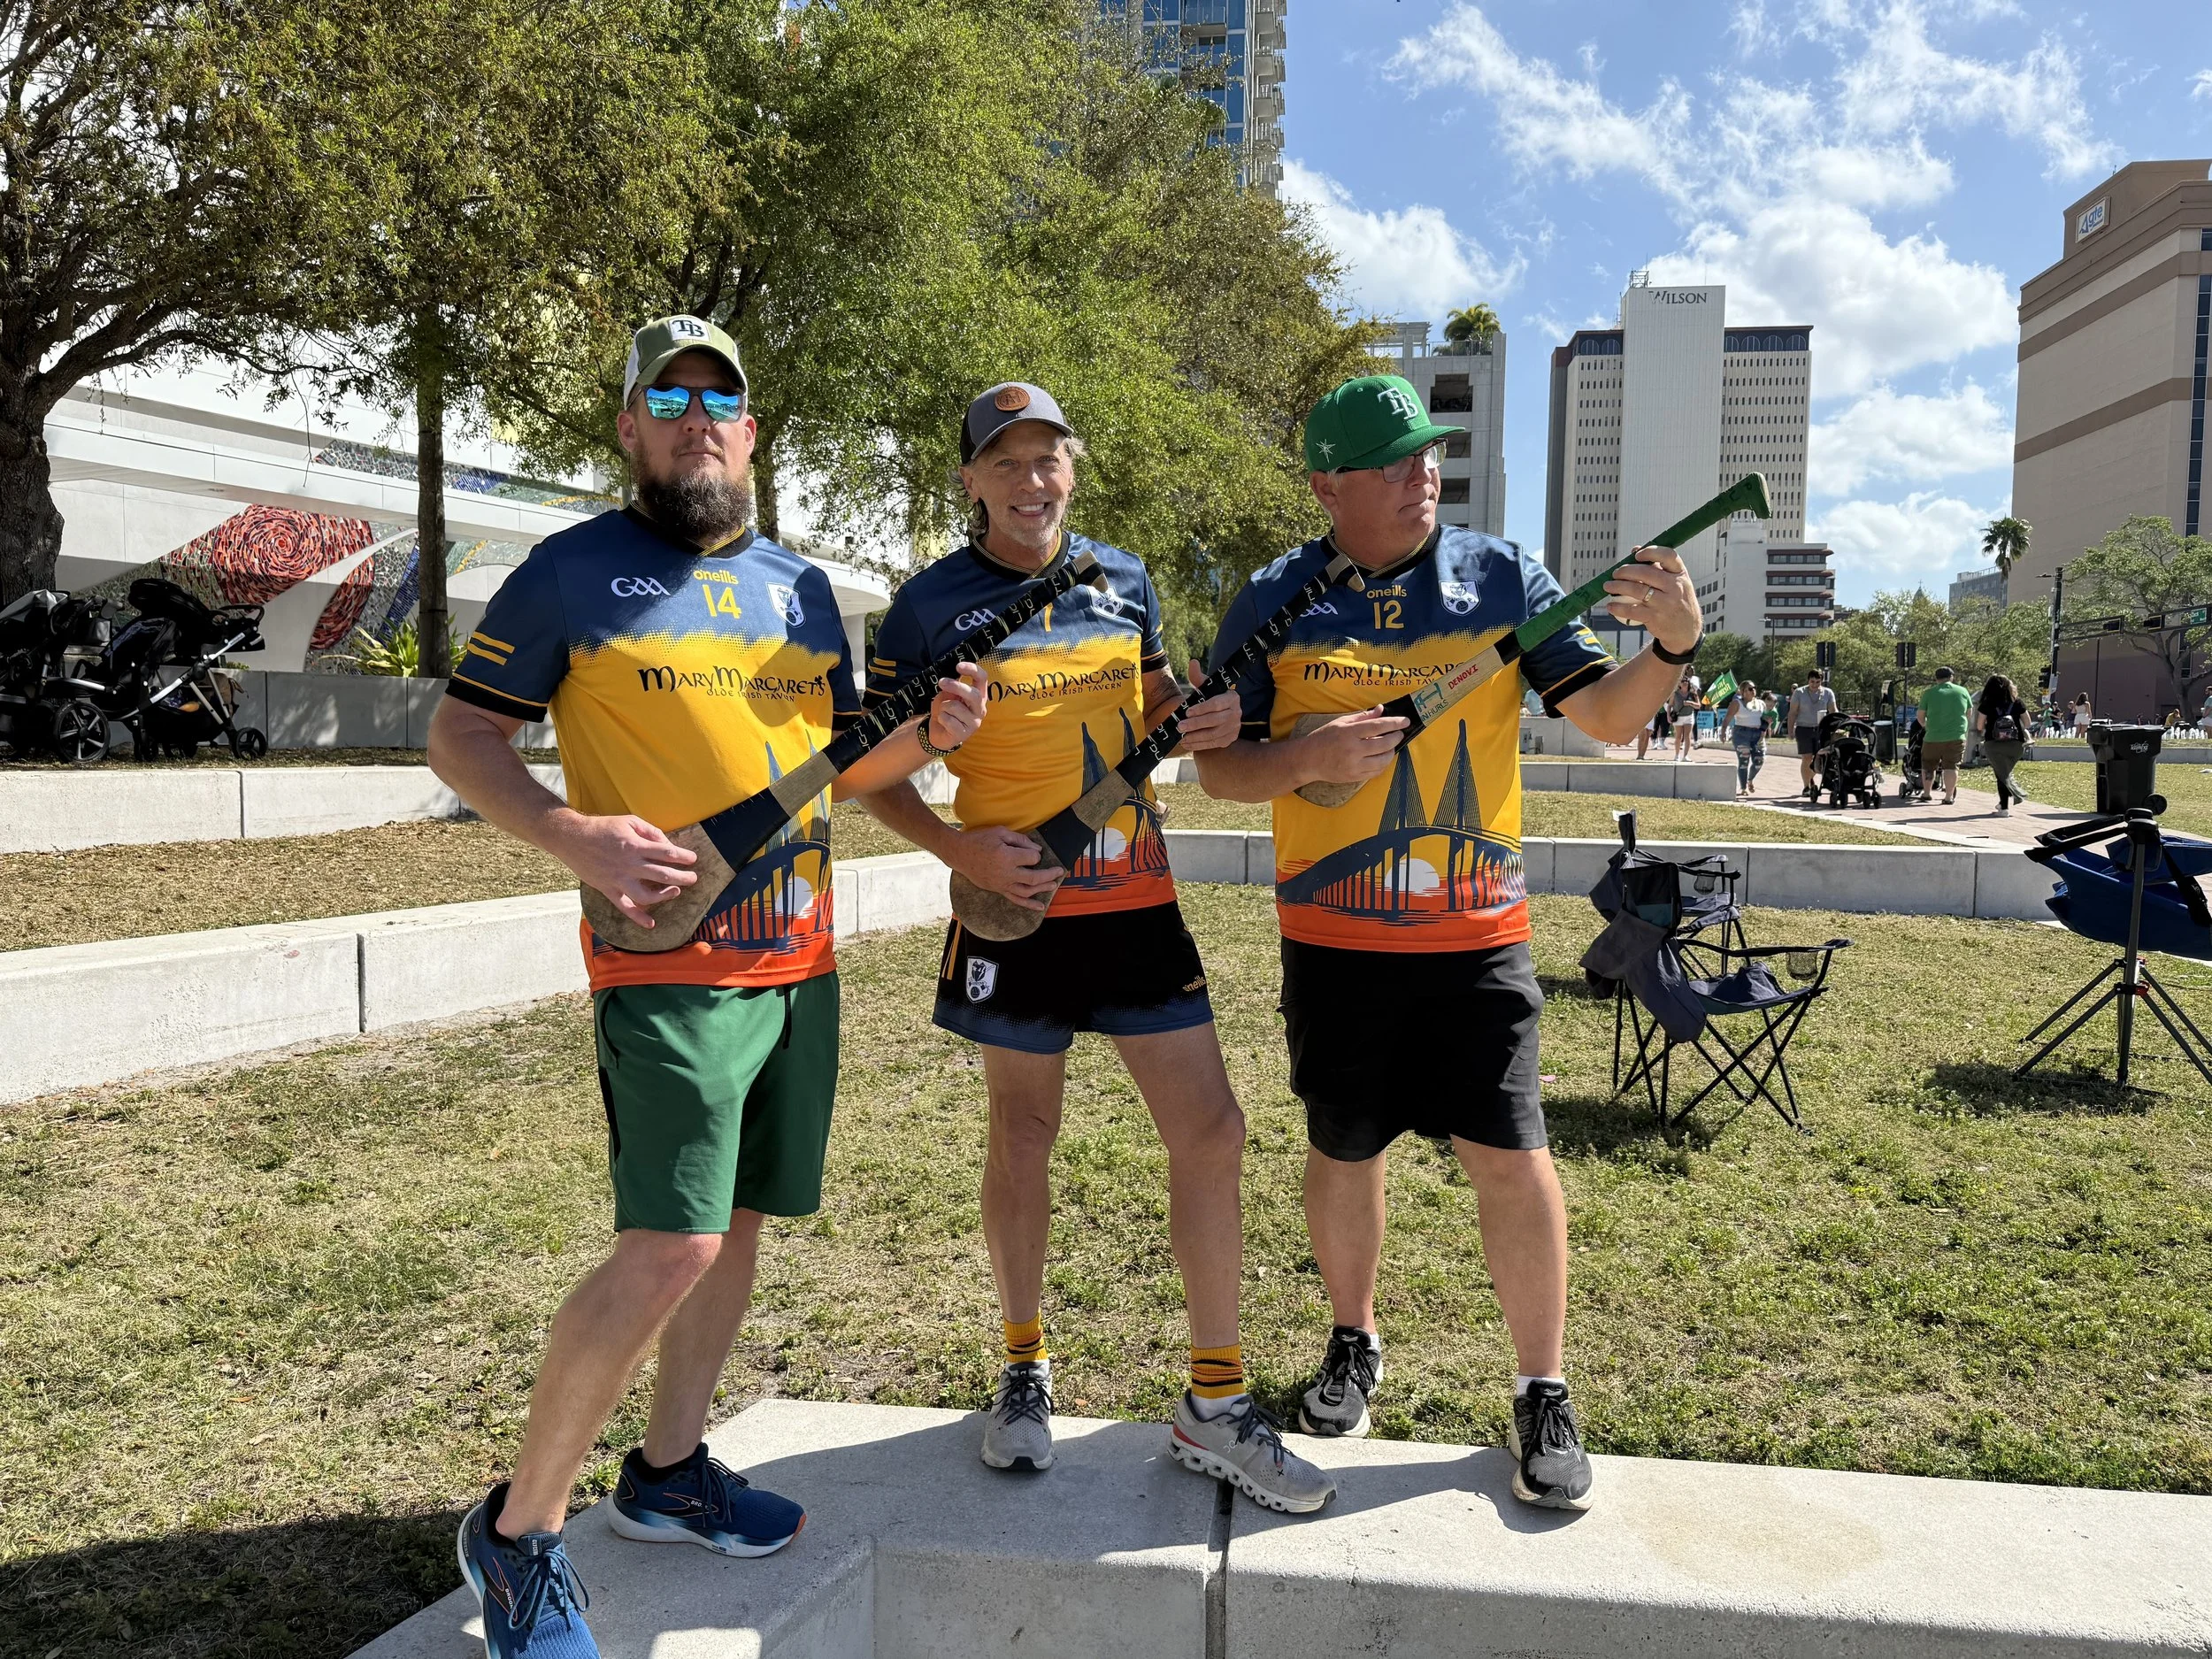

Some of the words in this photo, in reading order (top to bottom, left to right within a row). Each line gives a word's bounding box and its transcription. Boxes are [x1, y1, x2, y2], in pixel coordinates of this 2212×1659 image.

[1648, 290, 1707, 304] WILSON
[672, 319, 705, 337] TB
[1377, 387, 1418, 420] TB
[702, 584, 742, 619] 14
[1373, 600, 1405, 629] 12
[1448, 664, 1479, 689] DENOVI
[707, 688, 733, 697] OLDE
[738, 690, 762, 699] IRISH
[1029, 691, 1055, 701] OLDE
[1058, 687, 1084, 697] IRISH
[1087, 681, 1122, 693] TAVERN
